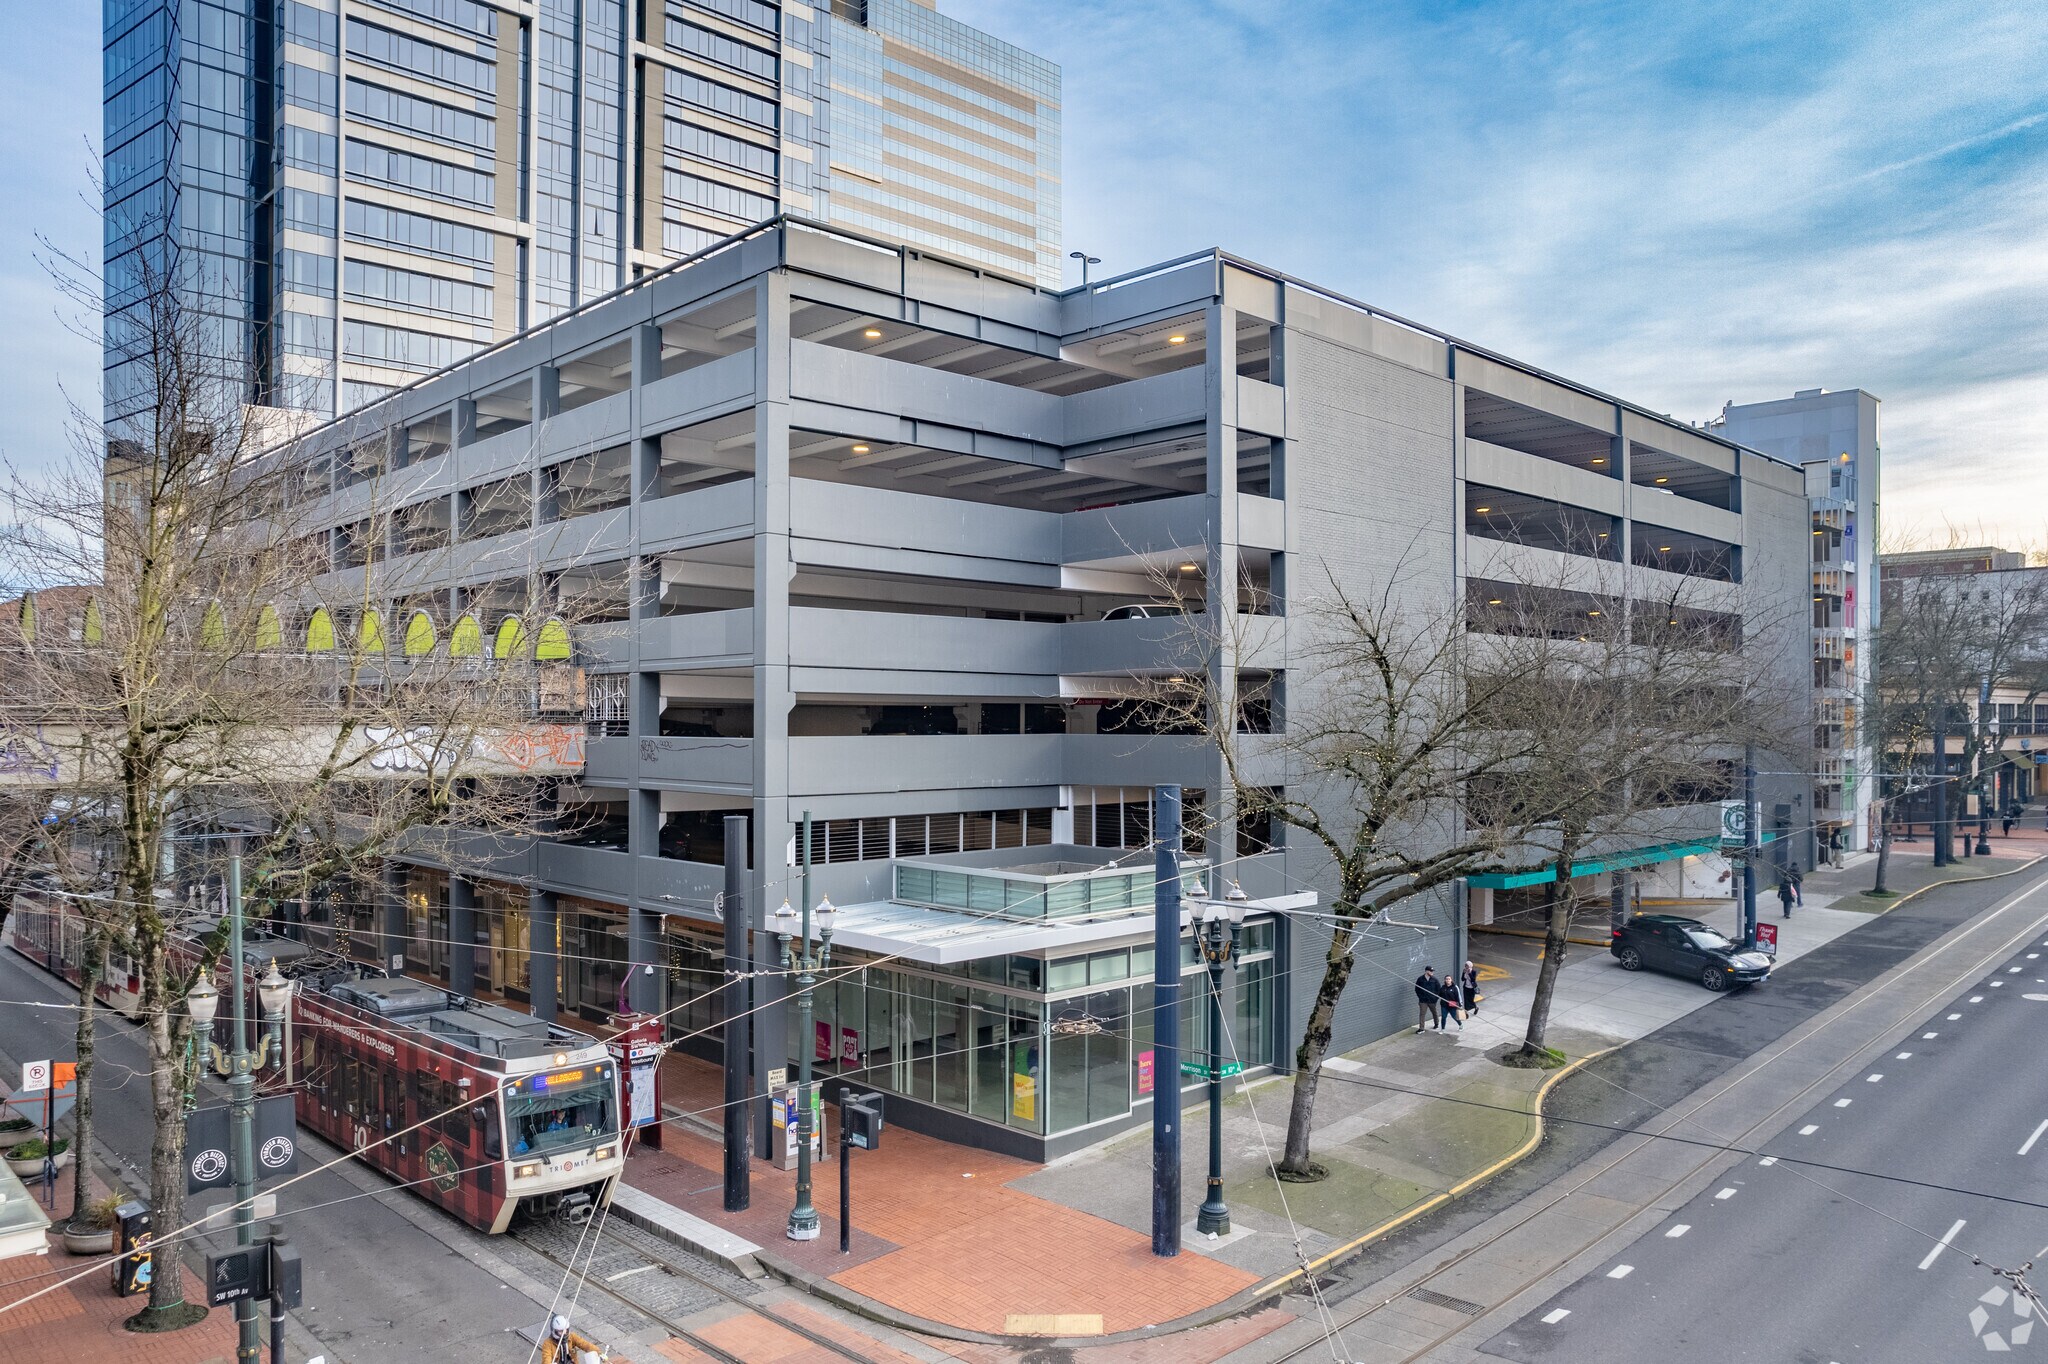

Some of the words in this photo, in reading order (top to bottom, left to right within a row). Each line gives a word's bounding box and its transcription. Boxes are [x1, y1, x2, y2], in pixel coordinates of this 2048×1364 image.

[303, 1008, 322, 1024] BANKING
[366, 1035, 395, 1056] EXPLORERS
[630, 1056, 654, 1065] Westbound
[1180, 1063, 1202, 1074] Morrison
[573, 1159, 589, 1168] MET
[215, 1291, 226, 1301] SW
[227, 1288, 240, 1298] 10th
[241, 1288, 249, 1296] Av
